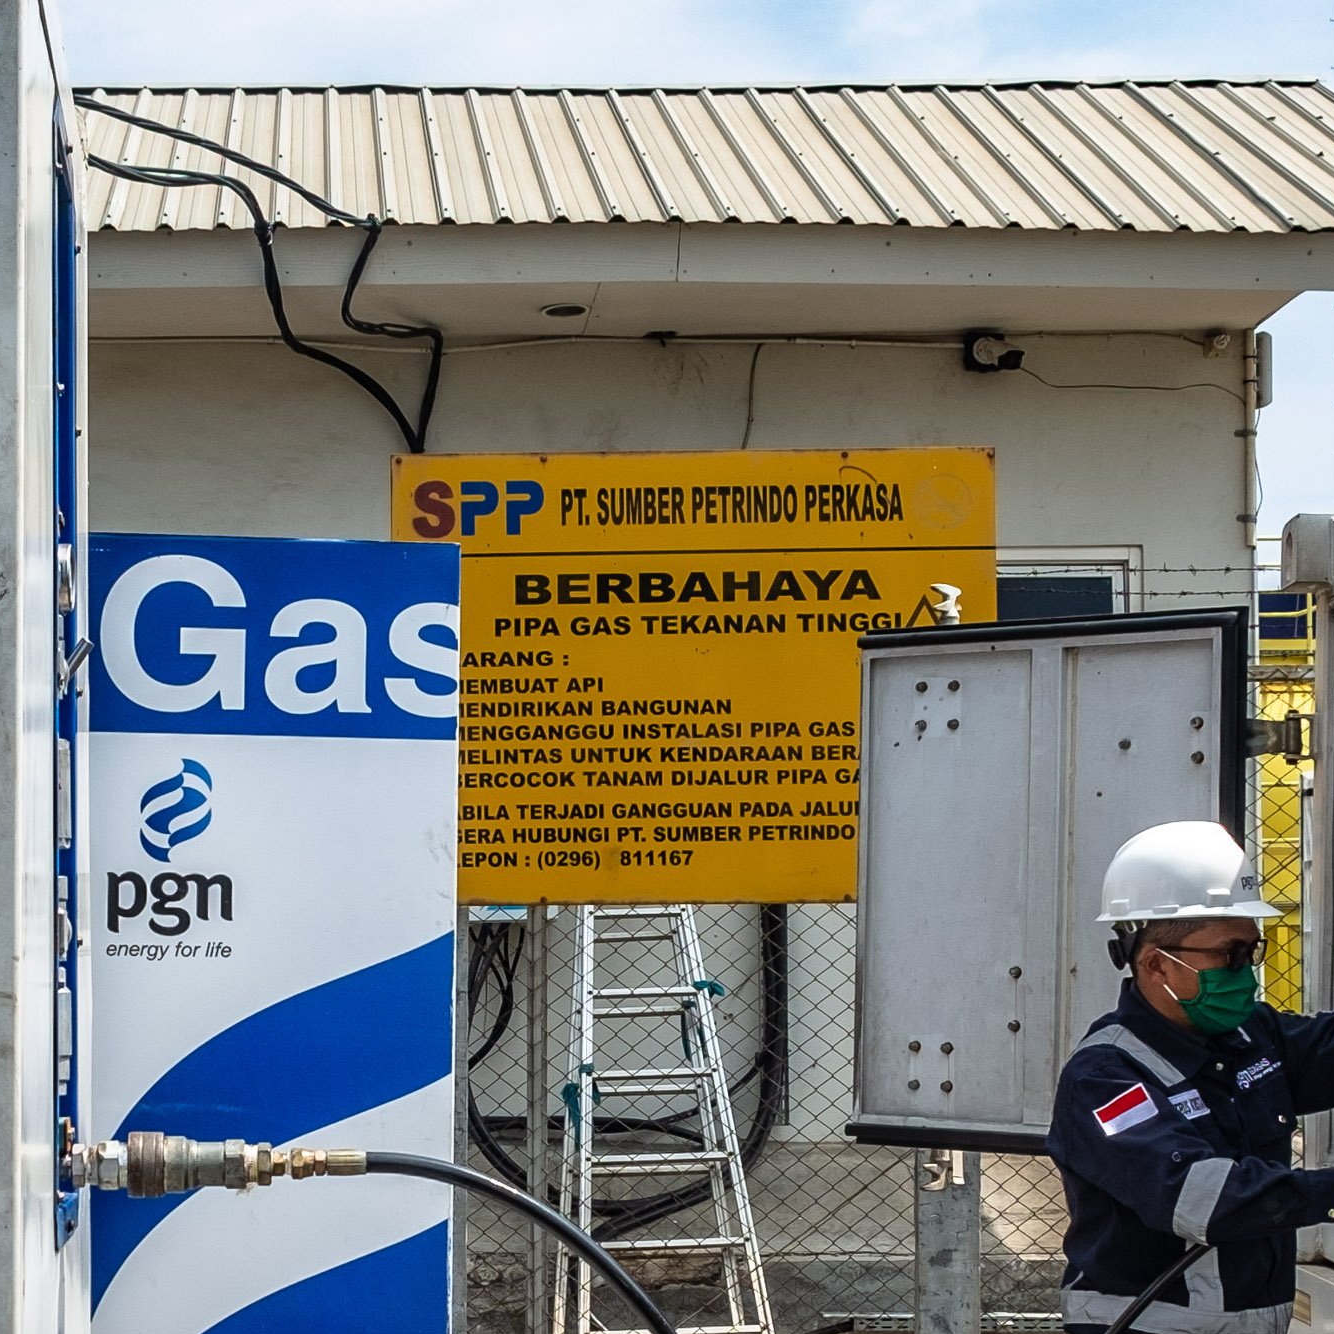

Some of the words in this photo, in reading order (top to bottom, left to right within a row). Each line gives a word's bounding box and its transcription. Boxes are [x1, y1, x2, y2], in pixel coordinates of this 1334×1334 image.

[412, 480, 544, 538] SPP
[561, 489, 589, 525] PT.
[598, 487, 684, 525] SUMBER
[692, 485, 797, 523] PETRINDO
[805, 484, 903, 521] PERKASA
[515, 570, 880, 605] BERBAHAYA
[495, 618, 560, 636] PIPA
[571, 616, 630, 635] GAS
[641, 615, 785, 634] TEKANAN
[797, 613, 903, 634] TINGGI
[100, 554, 459, 718] Gas
[460, 651, 553, 667] ARANG
[567, 678, 602, 692] API
[602, 700, 731, 715] BANGUNAN
[624, 723, 741, 739] INSTALASI
[751, 723, 800, 737] PIPA
[809, 722, 854, 737] GAS
[571, 748, 651, 763] UNTUK
[661, 746, 802, 762] KENDARAAN
[812, 745, 860, 760] BER
[583, 771, 662, 786] TANAM
[672, 770, 768, 785] DIJALUR
[777, 769, 825, 784] PIPA
[458, 805, 509, 820] BILA
[517, 804, 604, 819] TERJADI
[612, 803, 731, 818] GANGGUAN
[740, 802, 793, 817] PADA
[513, 828, 609, 843] HUBUNGI
[618, 827, 645, 842] PT.
[654, 827, 741, 842] SUMBER
[749, 825, 855, 840] PETRINDO
[458, 852, 517, 867] EPON
[538, 851, 600, 870] (0296)
[621, 850, 693, 866] 811167
[106, 871, 233, 936] pgn
[105, 943, 169, 961] energy
[175, 942, 200, 957] for
[205, 942, 232, 958] life
